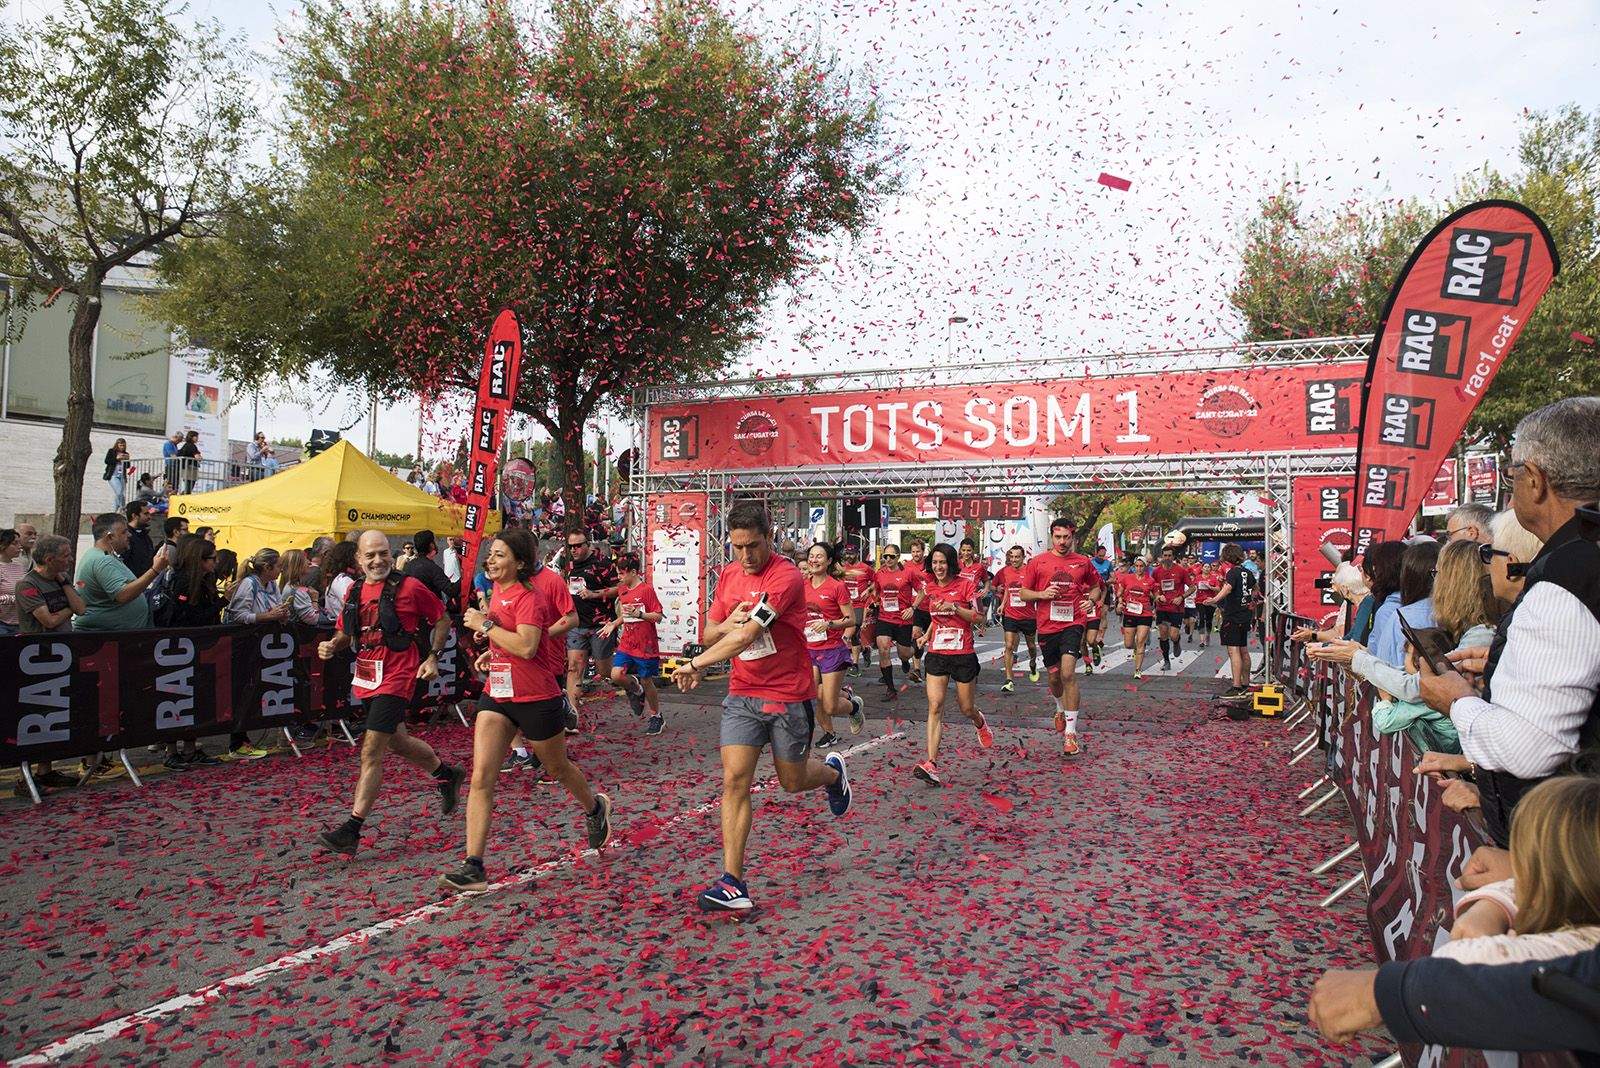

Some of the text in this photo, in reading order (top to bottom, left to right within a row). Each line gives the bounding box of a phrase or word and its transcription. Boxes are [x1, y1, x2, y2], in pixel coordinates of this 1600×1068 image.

[1447, 233, 1491, 297] RAC
[492, 344, 506, 395] RAC
[1402, 314, 1437, 372] RAC
[1464, 315, 1518, 397] rac1.cat
[810, 390, 1151, 454] TOTS SOM 1
[1309, 382, 1336, 432] RAC
[1382, 397, 1409, 443] RAC
[663, 419, 680, 458] RAC
[1322, 488, 1340, 519] RAC
[1366, 467, 1388, 505] RAC
[361, 512, 411, 521] CHAMPIONCHIP
[16, 642, 73, 747] RAC
[155, 637, 195, 730] RAC
[261, 633, 294, 717] RAC
